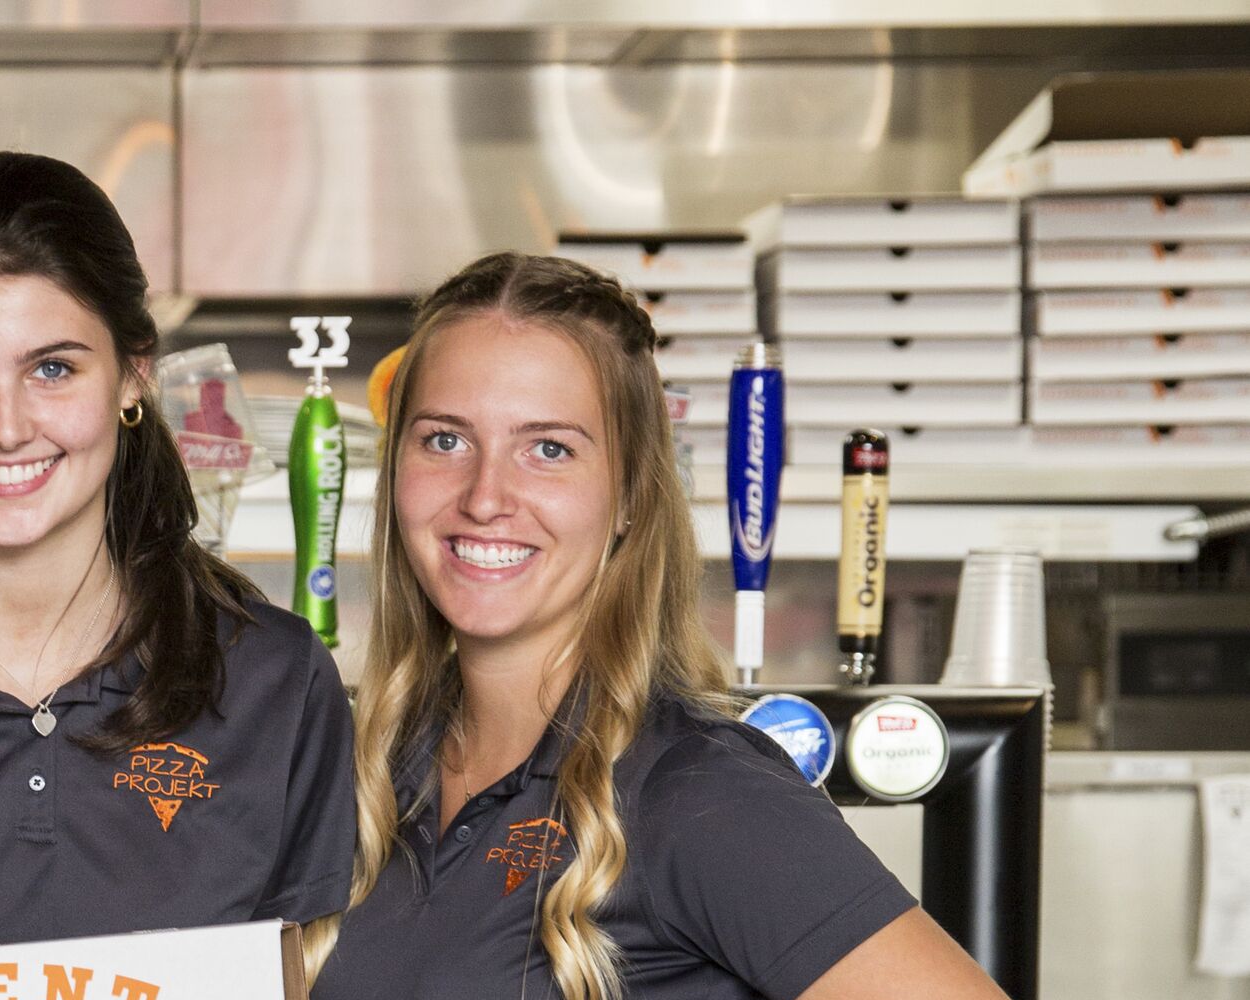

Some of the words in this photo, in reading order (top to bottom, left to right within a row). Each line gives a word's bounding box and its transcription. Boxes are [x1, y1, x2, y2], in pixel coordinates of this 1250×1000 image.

[288, 316, 352, 367] 33
[314, 424, 343, 489] ROCK
[857, 495, 880, 608] Organic
[113, 772, 221, 798] PROJEKT
[131, 755, 204, 779] PIZZA
